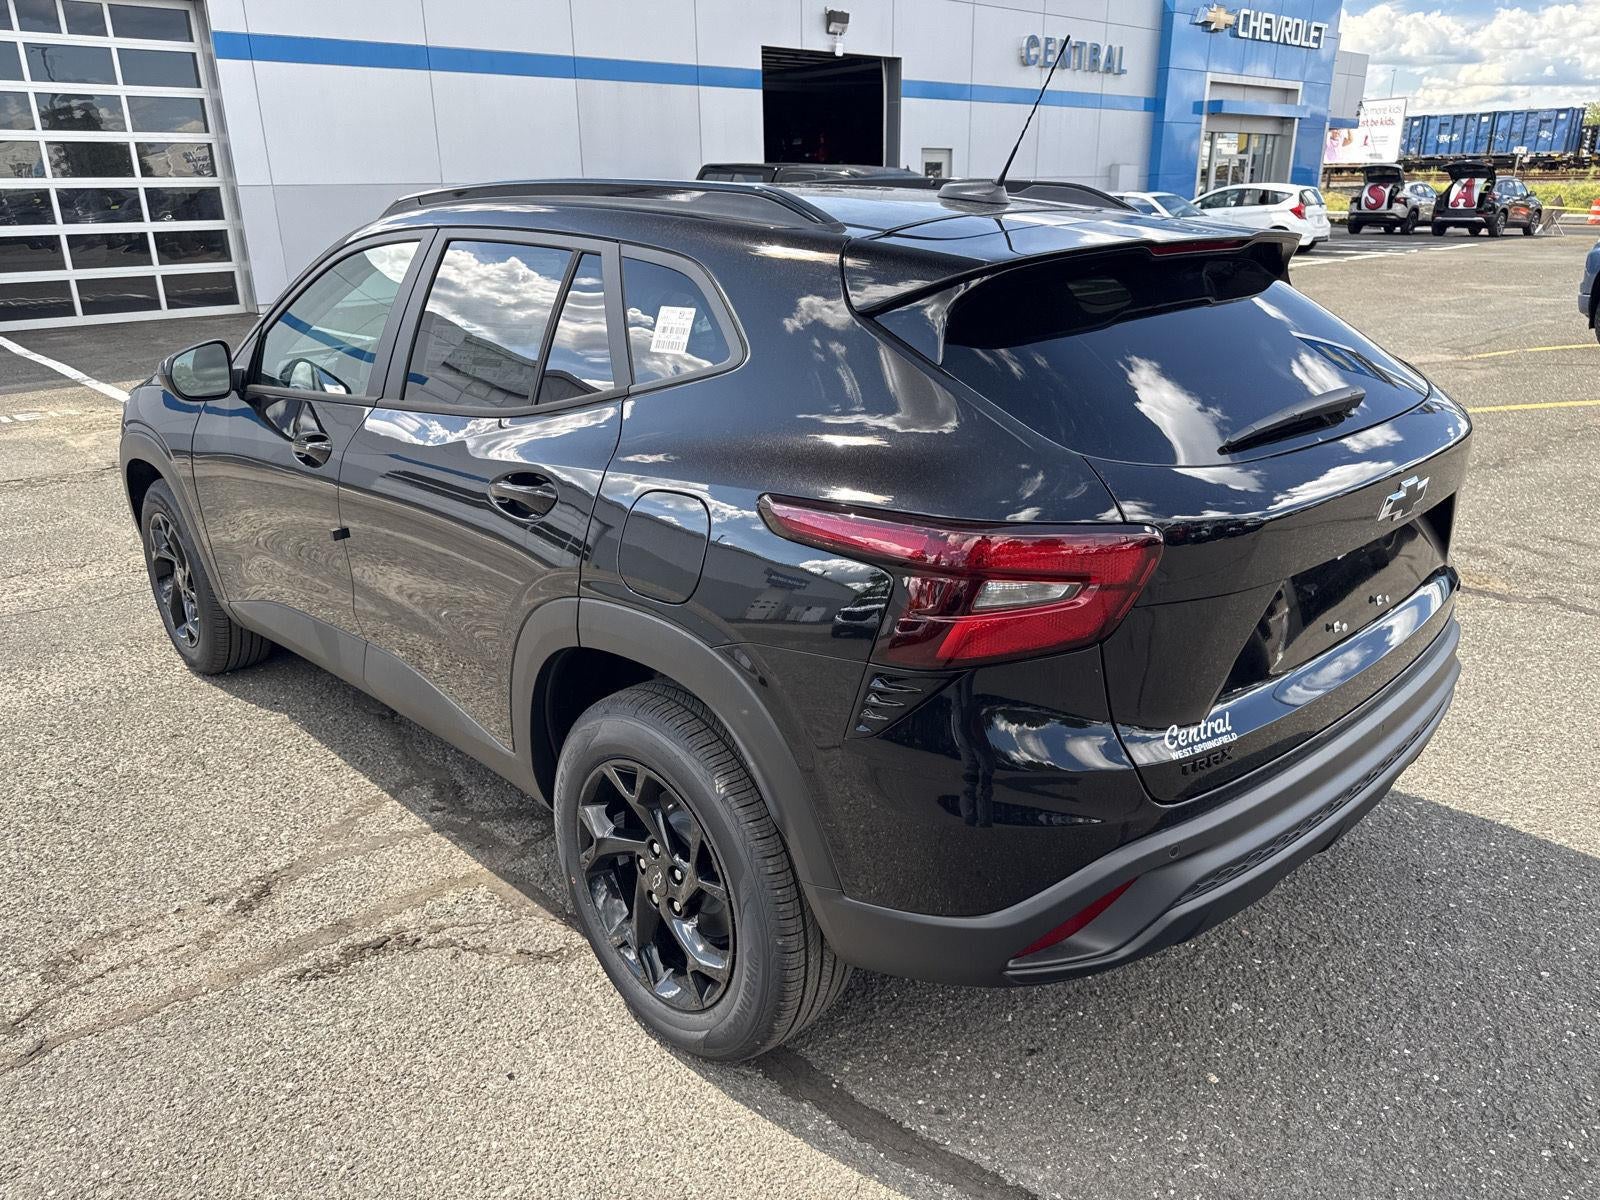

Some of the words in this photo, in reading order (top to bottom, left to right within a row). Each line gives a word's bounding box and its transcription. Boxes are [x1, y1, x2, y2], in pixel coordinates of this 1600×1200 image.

[1238, 8, 1329, 49] CHEVROLET
[1021, 34, 1127, 75] CENTRAL
[1364, 183, 1390, 210] S
[1450, 177, 1476, 207] A
[1164, 711, 1232, 750] Central
[1170, 747, 1193, 760] WEST
[1194, 732, 1238, 754] SPRINGFIELD
